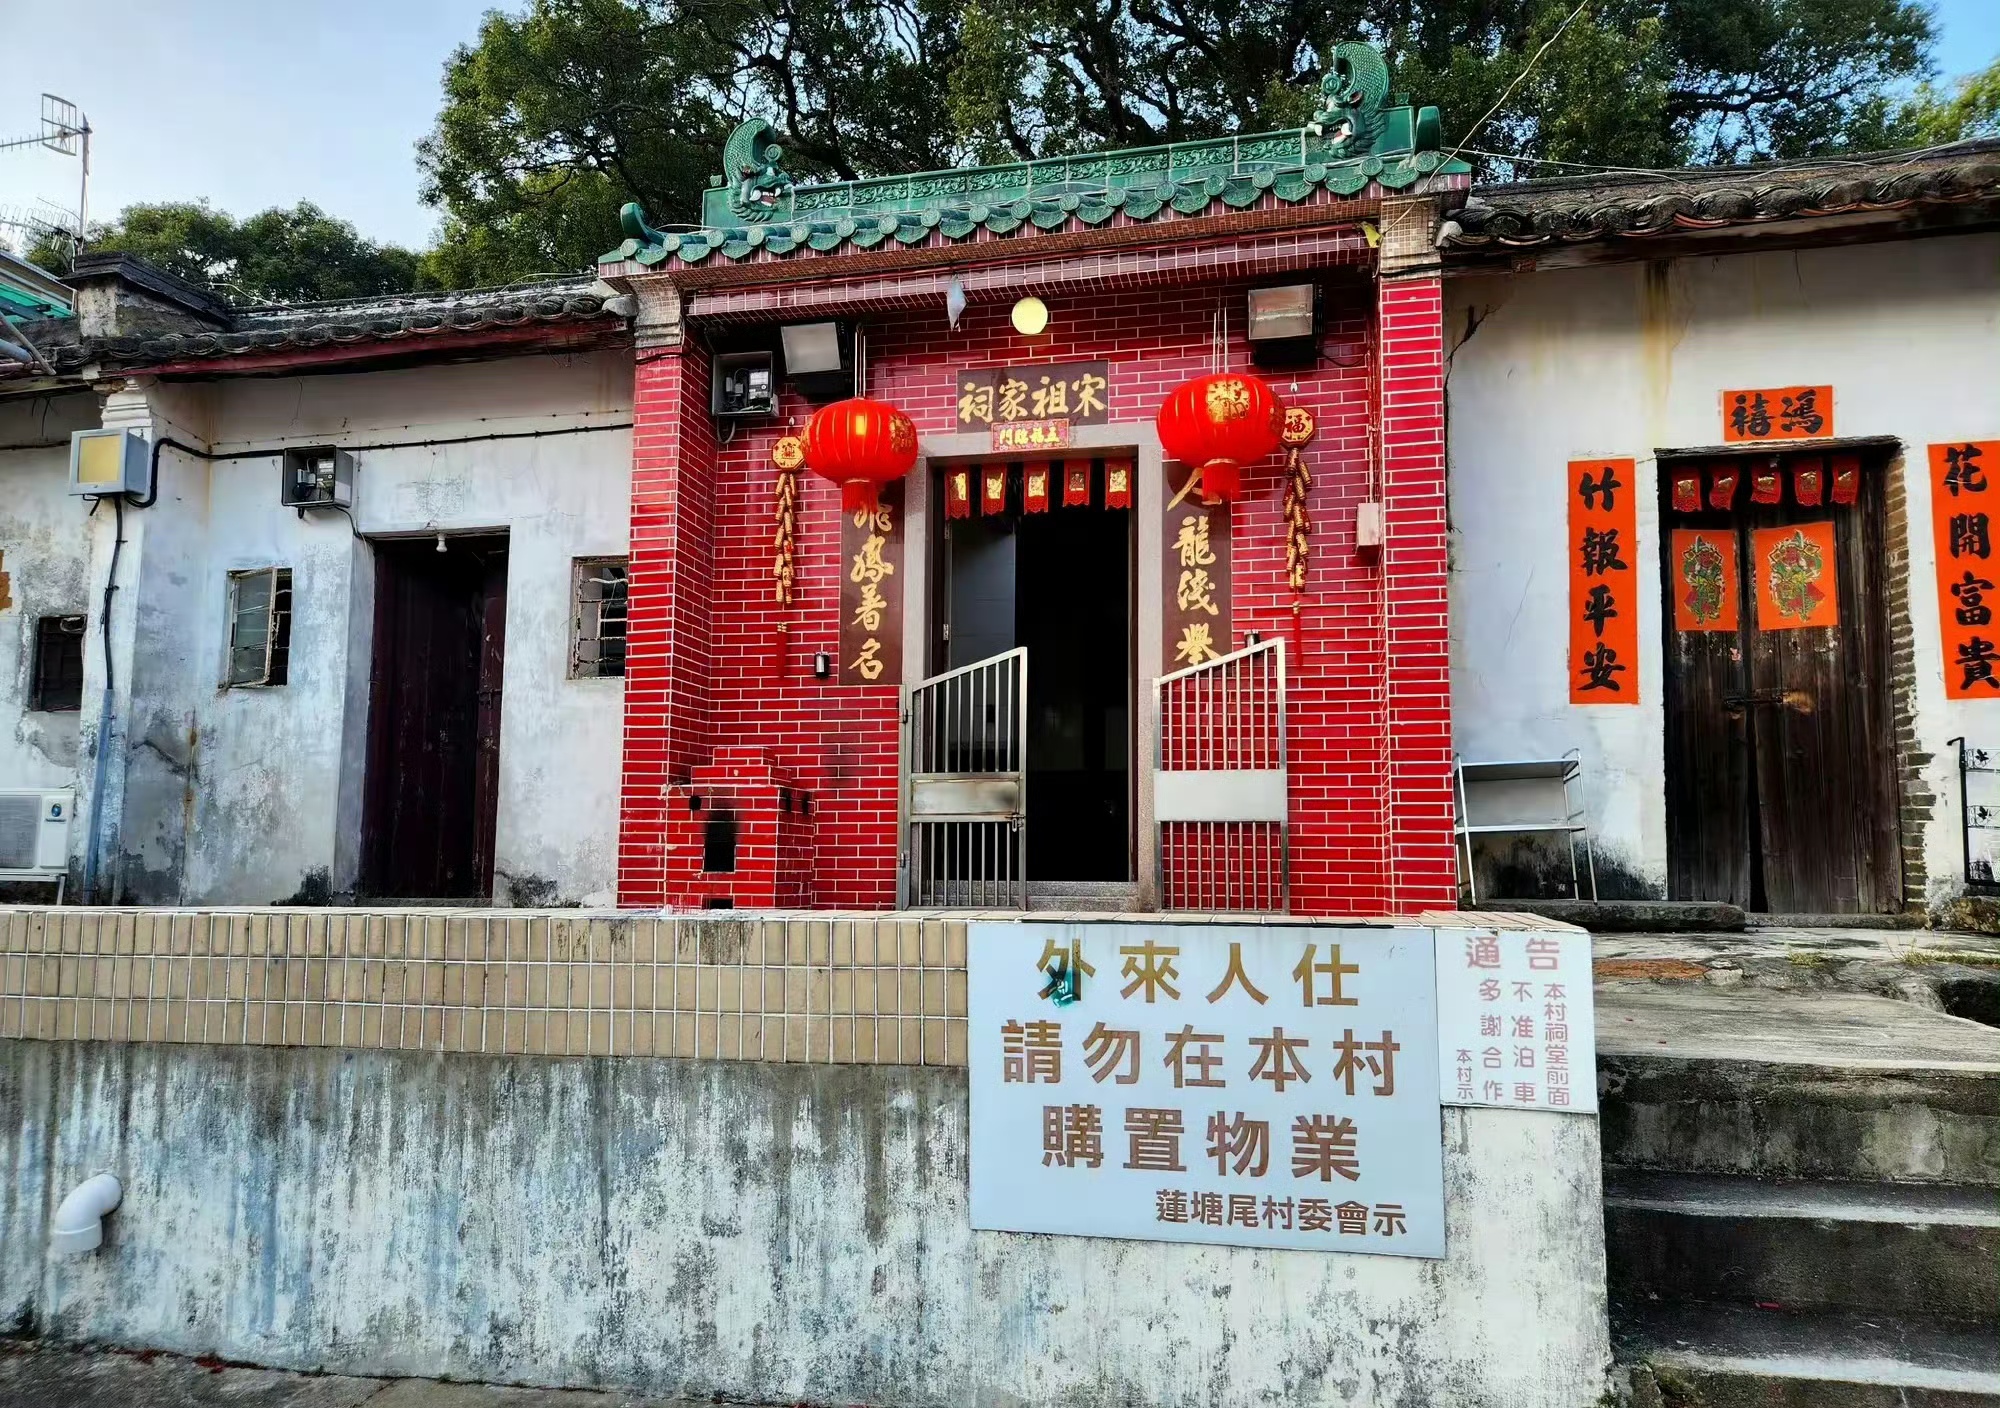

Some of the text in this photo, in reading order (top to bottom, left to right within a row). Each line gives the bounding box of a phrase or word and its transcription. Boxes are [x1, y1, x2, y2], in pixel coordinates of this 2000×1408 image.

[1577, 466, 1628, 692] 竹報平安
[1943, 443, 2000, 690] 花開富貴
[1036, 938, 1360, 1007] 外來人仕
[1465, 936, 1560, 970] 通告
[1001, 1019, 1401, 1097] 請勿在本村
[1456, 1048, 1474, 1100] 本村示
[1479, 978, 1504, 1101] 多謝合作
[1511, 981, 1537, 1104] 不准泊車
[1543, 983, 1570, 1106] 本村祠堂前面
[1042, 1104, 1361, 1182] 購置物業
[1156, 1189, 1407, 1237] 蓮塘尾村委會示
